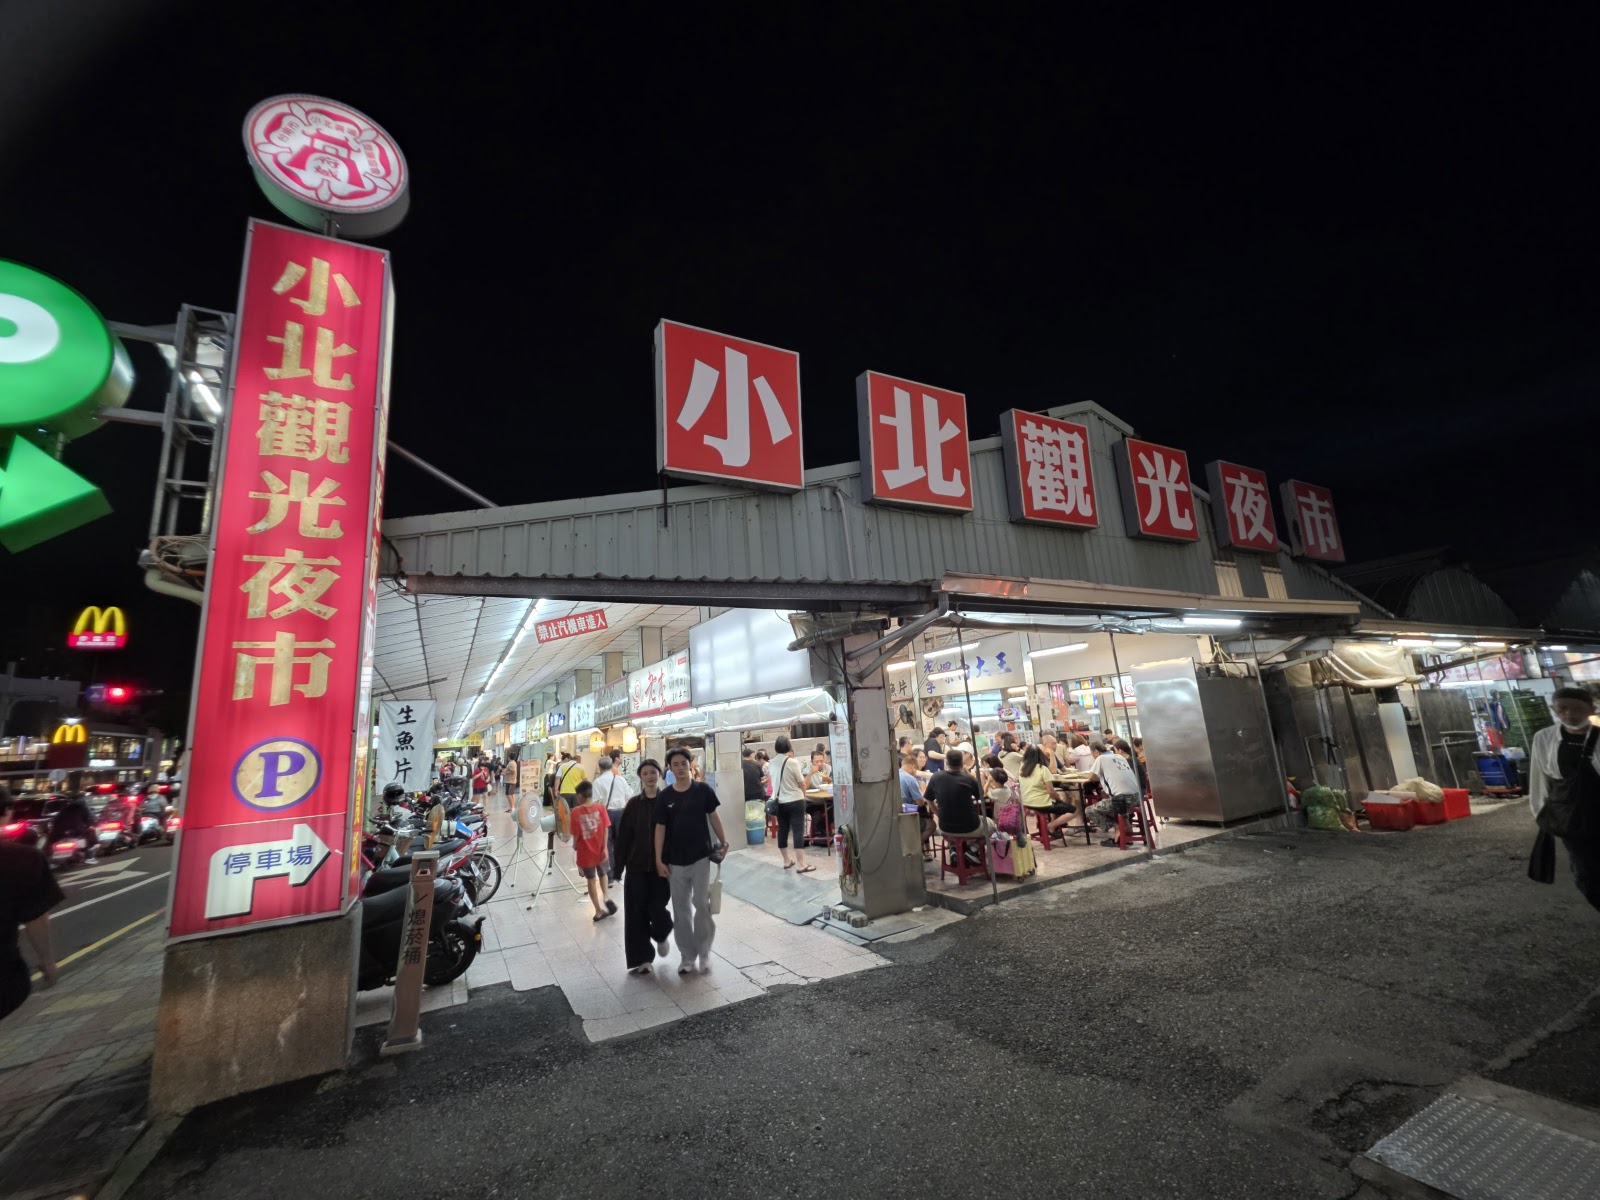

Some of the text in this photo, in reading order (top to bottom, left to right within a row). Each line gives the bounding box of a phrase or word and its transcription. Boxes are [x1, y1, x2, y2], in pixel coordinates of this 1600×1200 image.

[676, 346, 1338, 554] 小北觀光夜市
[232, 257, 362, 707] 小北觀光夜市
[537, 613, 606, 640] 禁止汽機車進入
[393, 705, 417, 784] 生魚片
[255, 751, 305, 798] P
[223, 845, 313, 875] 停車場
[403, 909, 426, 965] 熄菸桶
